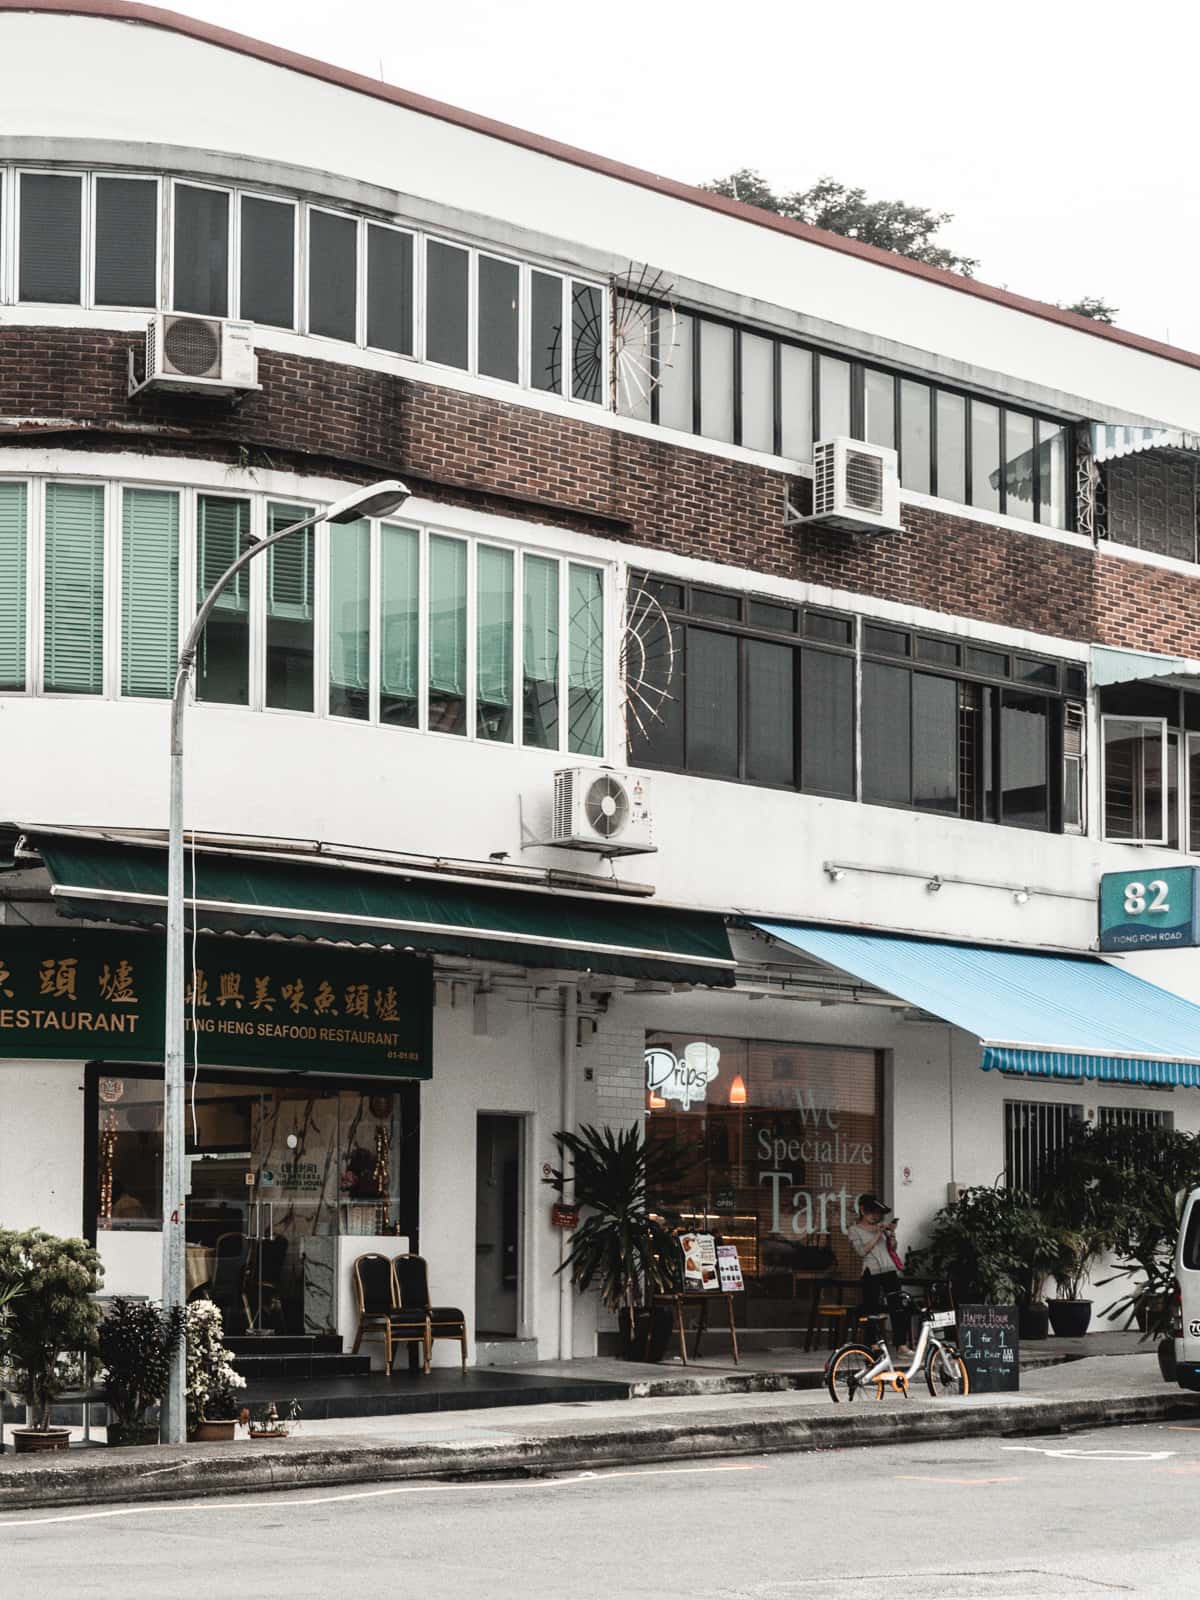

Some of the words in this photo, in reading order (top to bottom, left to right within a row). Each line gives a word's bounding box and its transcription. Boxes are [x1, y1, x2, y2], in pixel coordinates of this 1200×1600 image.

[1124, 880, 1170, 915] 82
[1112, 934, 1138, 944] TIONG
[1140, 933, 1157, 943] POH
[1159, 931, 1183, 941] ROAD
[184, 1018, 215, 1034] TING
[218, 1020, 254, 1036] HENG
[257, 1023, 317, 1041] SEAFOOD
[319, 1027, 400, 1046] RESTAURANT
[645, 1052, 708, 1106] Drips
[794, 1087, 841, 1130] We
[758, 1129, 873, 1170] Specialize
[819, 1168, 833, 1187] in
[170, 1210, 179, 1225] 4
[962, 1309, 986, 1324] HAPPY
[988, 1307, 1009, 1324] HOUR
[965, 1330, 973, 1348] 1
[998, 1330, 1007, 1348] 1
